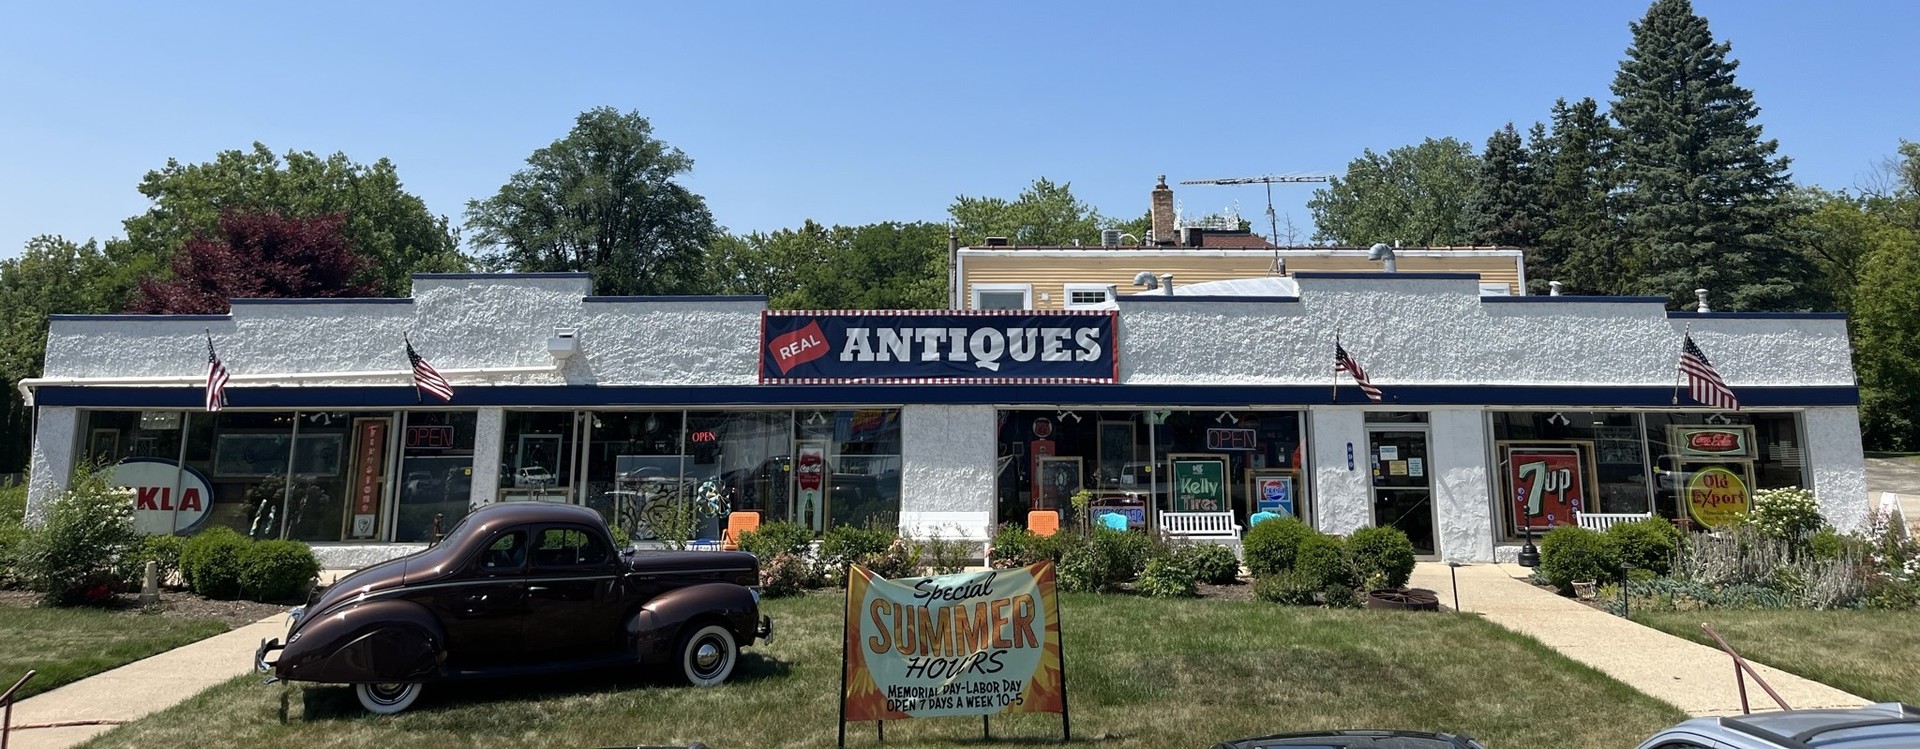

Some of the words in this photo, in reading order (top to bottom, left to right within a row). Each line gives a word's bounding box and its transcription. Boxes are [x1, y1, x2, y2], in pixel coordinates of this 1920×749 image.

[780, 334, 821, 360] REAL
[840, 327, 1102, 372] ANTIQUES
[407, 428, 452, 447] OPEN
[692, 431, 716, 442] OPEN
[1209, 430, 1256, 448] OPEN
[1180, 477, 1219, 497] Kelly
[1703, 473, 1729, 488] Old
[125, 486, 202, 512] KLA
[1180, 495, 1218, 511] Tires
[913, 572, 997, 608] Special
[868, 593, 1040, 657] SUMMER
[905, 650, 1008, 679] HOURS
[887, 684, 939, 699] MEMORIAL
[1002, 679, 1022, 692] DAY
[886, 699, 916, 712] OPEN
[919, 699, 927, 711] 7
[928, 697, 954, 710] DAYS
[956, 697, 964, 708] A
[965, 695, 994, 708] WEEK
[996, 692, 1024, 707] 10-5
